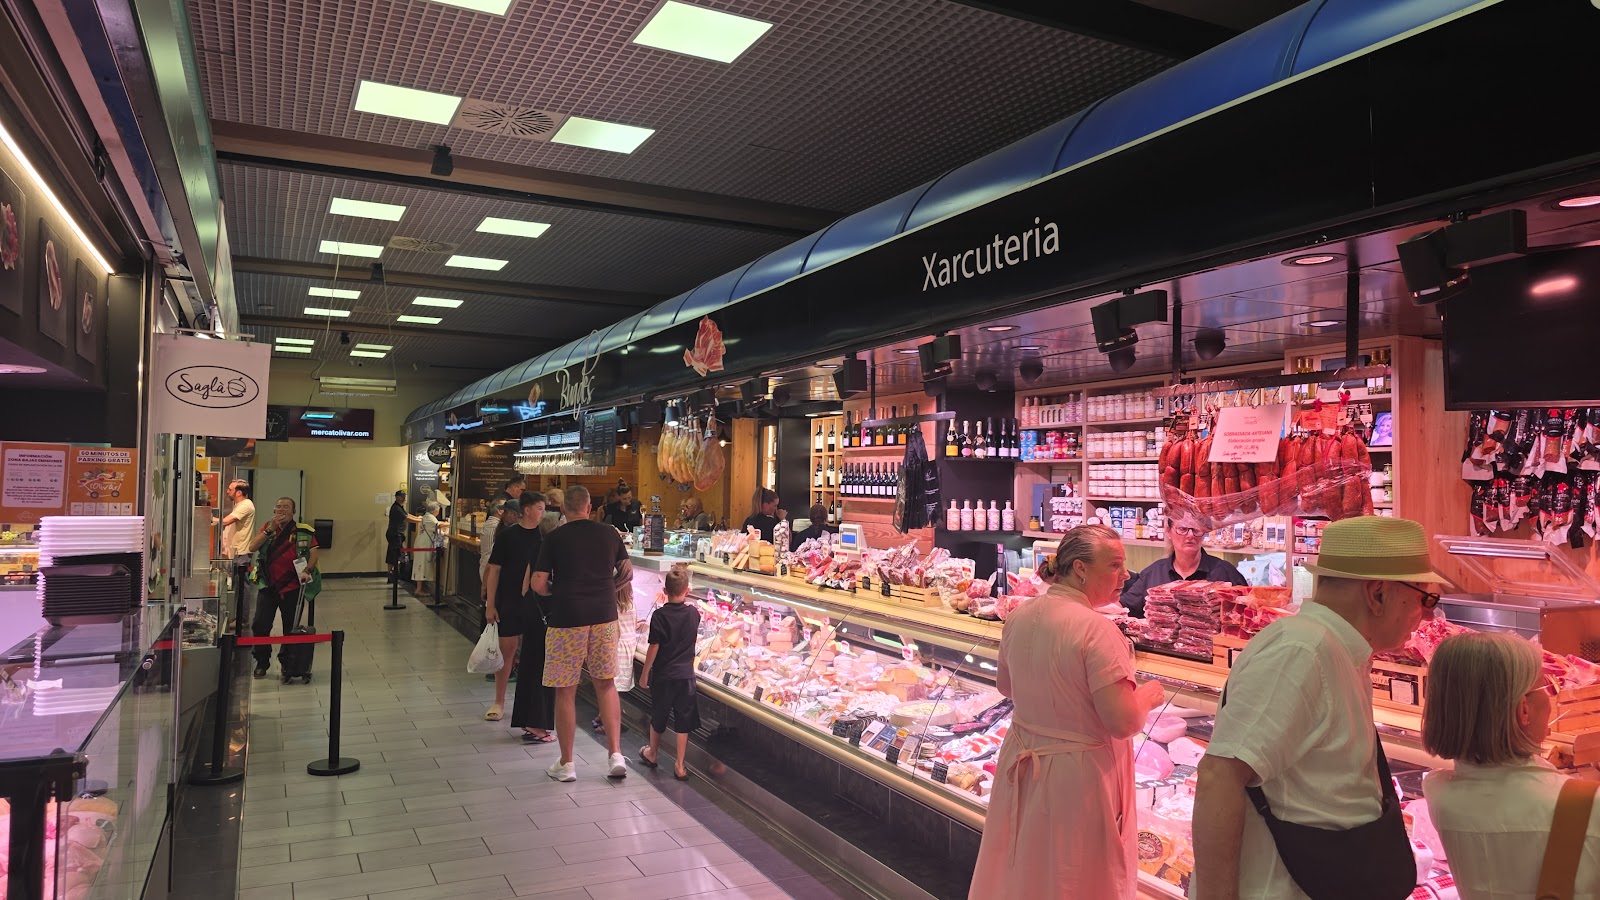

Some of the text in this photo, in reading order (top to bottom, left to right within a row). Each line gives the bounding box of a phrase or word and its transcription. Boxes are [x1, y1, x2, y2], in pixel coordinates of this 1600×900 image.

[922, 216, 1060, 292] Xarcuteria
[177, 373, 225, 399] Saglà
[311, 429, 369, 437] mercatolivar.com
